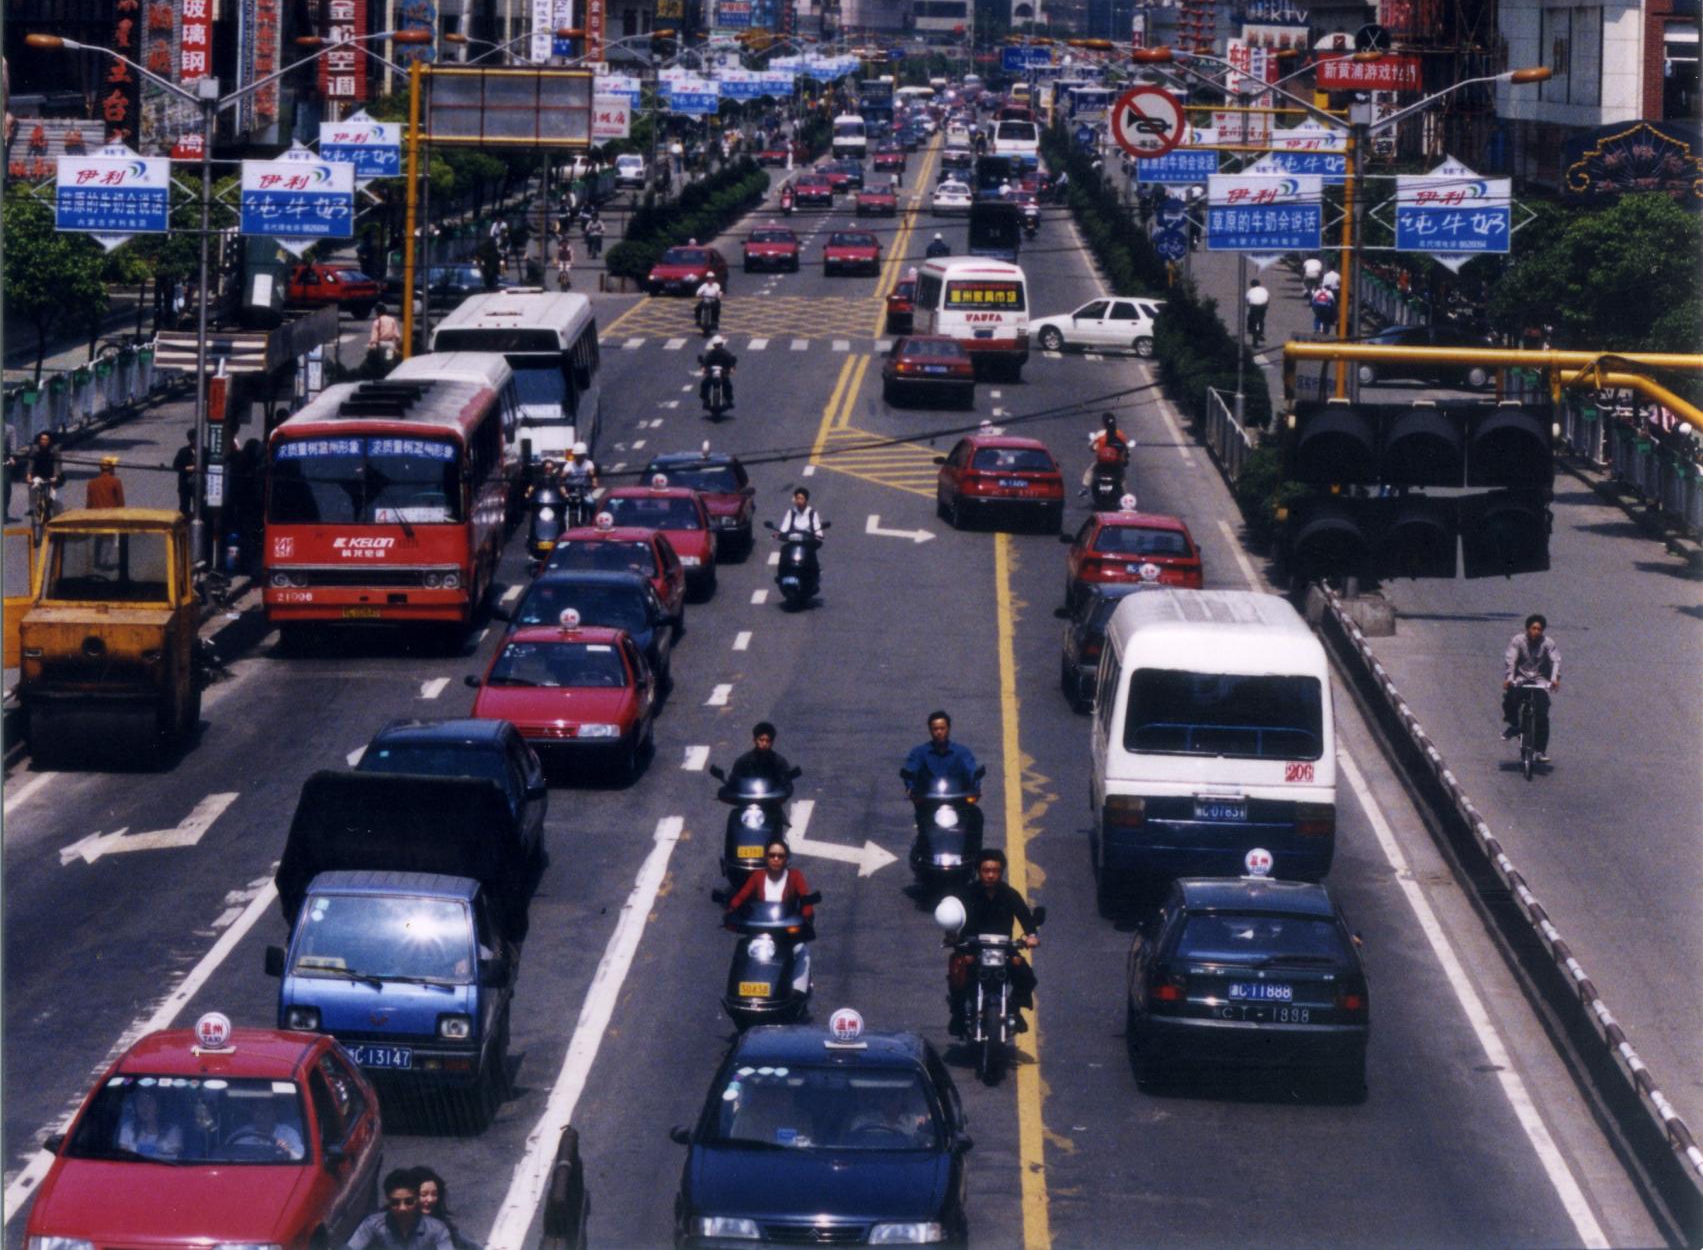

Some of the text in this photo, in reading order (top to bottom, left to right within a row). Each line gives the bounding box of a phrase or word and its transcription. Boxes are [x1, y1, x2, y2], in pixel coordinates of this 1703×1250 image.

[1271, 10, 1308, 23] KTV
[333, 132, 369, 143] 伊利
[76, 169, 127, 185] 伊利
[258, 174, 310, 190] 伊利
[1226, 188, 1279, 205] 伊利
[1415, 190, 1466, 205] 伊利
[245, 195, 349, 220] 纯牛奶
[1211, 209, 1317, 233] 草原的牛奶会说话
[1400, 212, 1506, 235] 纯牛奶
[1284, 763, 1313, 782] 206
[202, 1022, 223, 1035] 温州
